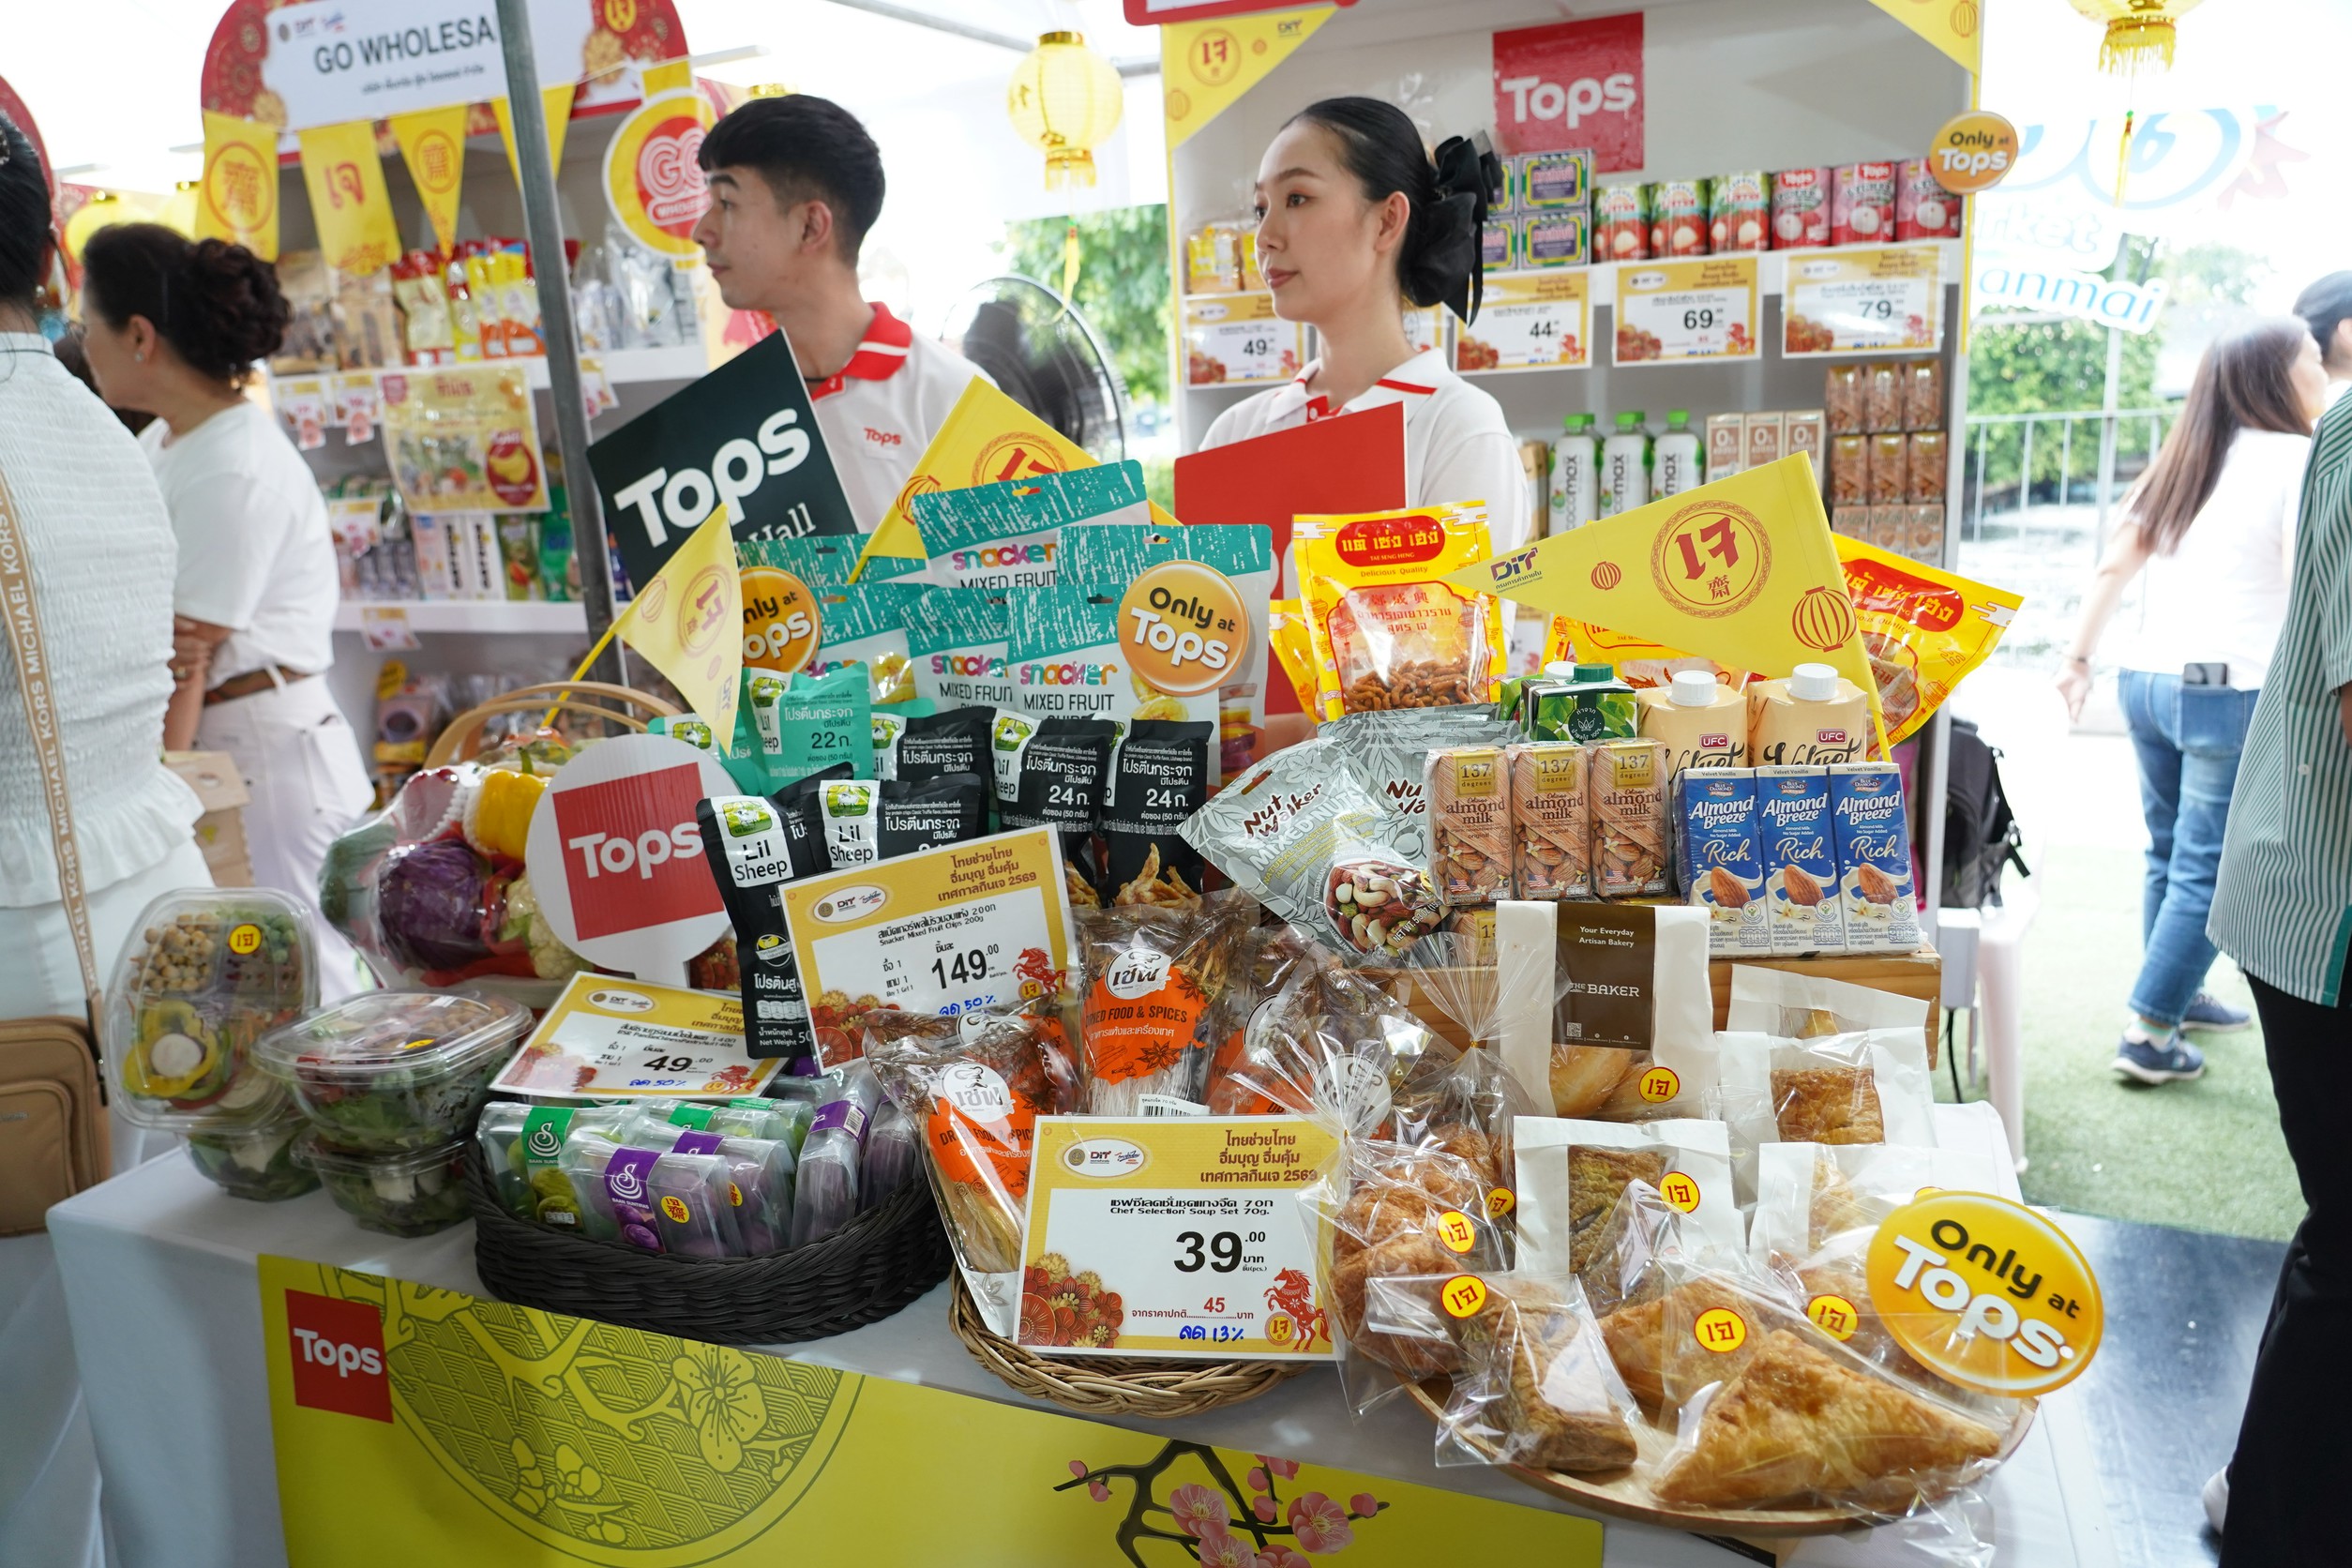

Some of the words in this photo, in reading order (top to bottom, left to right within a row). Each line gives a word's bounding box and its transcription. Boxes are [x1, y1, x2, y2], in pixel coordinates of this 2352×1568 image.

[314, 42, 354, 74] GO
[358, 15, 496, 67] WHOLESA
[1500, 73, 1637, 128] Tops
[1949, 130, 1996, 149] Only
[1937, 147, 2009, 177] Tops
[1683, 308, 1714, 330] 69
[1858, 300, 1893, 321] 79
[1529, 321, 1553, 339] 44
[1243, 338, 1269, 356] 49
[863, 427, 902, 447] Tops
[613, 407, 811, 549] Tops
[1674, 516, 1739, 581] เจ
[1360, 569, 1396, 578] Delicious
[1399, 565, 1428, 576] Quality
[743, 594, 780, 623] nly
[783, 590, 798, 607] at
[1148, 586, 1214, 630] Only
[1216, 616, 1236, 633] at
[8, 579, 41, 674] MICHAEL
[743, 610, 812, 665] ops
[1129, 606, 1230, 671] Tops
[1019, 659, 1118, 686] snacker
[939, 681, 972, 700] MIXED
[30, 679, 53, 740] KORS
[1023, 694, 1065, 711] MIXED
[1069, 694, 1115, 711] FRUIT
[784, 705, 853, 722] โปรตีนกระจก
[810, 731, 837, 750] 22
[1702, 736, 1726, 747] UFC
[1820, 731, 1845, 742] UFC
[902, 750, 973, 765] โปรตีนกระจก
[1026, 755, 1097, 776] โปรตีนกระจก
[1540, 759, 1571, 775] 137
[1618, 754, 1650, 771] 137
[1123, 758, 1193, 777] โปรตีนกระจก
[1460, 762, 1491, 779] 137
[42, 740, 71, 839] MICHAEL
[1048, 784, 1075, 806] 24
[1146, 788, 1170, 808] 24
[1603, 789, 1664, 806] almond
[1446, 800, 1506, 815] almond
[1525, 794, 1585, 810] almond
[1620, 802, 1652, 816] milk
[1689, 794, 1756, 821] Almond
[1761, 792, 1828, 819] Almond
[1835, 791, 1901, 816] Almond
[884, 815, 961, 832] โปรตีนกระจก
[1462, 812, 1493, 824] milk
[1541, 807, 1573, 821] milk
[1703, 811, 1747, 830] Breeze
[1775, 809, 1820, 828] Breeze
[1848, 807, 1893, 826] Breeze
[838, 825, 861, 843] Lil
[568, 822, 704, 880] Tops
[744, 839, 771, 861] Lil
[829, 845, 874, 865] Sheep
[950, 845, 1013, 870] ไทยช่วยไทย
[1702, 837, 1751, 867] Rich
[1775, 836, 1824, 864] Rich
[1849, 835, 1899, 862] Rich
[59, 837, 83, 898] KORS
[734, 858, 789, 882] Sheep
[949, 866, 985, 885] อิ่มบุญ
[988, 859, 1019, 878] อิ่มคุ้ม
[938, 879, 1005, 902] เทศกาลกินเจ
[1009, 871, 1037, 887] 2569
[880, 934, 906, 946] Snacker
[907, 929, 927, 941] Mixed
[928, 925, 944, 935] Fruit
[945, 920, 963, 931] Chips
[1579, 926, 1598, 935] Your
[1600, 927, 1635, 937] Everyday
[1578, 937, 1606, 946] Artisan
[1608, 938, 1635, 948] Bakery
[931, 949, 987, 990] 149
[1587, 983, 1639, 997] BAKER
[1108, 1006, 1134, 1020] FOOD
[1136, 1005, 1145, 1018] &
[1149, 1005, 1188, 1023] SPICES
[774, 1038, 797, 1047] Weight
[643, 1055, 694, 1072] 49
[1225, 1128, 1296, 1147] ไทยช่วยไทย
[1219, 1151, 1259, 1167] อิ่มบุญ
[1262, 1151, 1301, 1168] อิ่มคุ้ม
[1200, 1169, 1280, 1184] เทศกาลกินเจ
[1110, 1207, 1135, 1215] Chef
[1138, 1207, 1185, 1215] Selection
[1189, 1207, 1216, 1216] Soup
[1221, 1207, 1239, 1215] Set
[1172, 1230, 1244, 1274] 39
[1243, 1254, 1265, 1265] บาท
[1930, 1218, 2043, 1300] Only
[2047, 1289, 2081, 1319] at
[1203, 1297, 1226, 1312] 45
[1892, 1234, 2066, 1368] Tops
[1236, 1311, 1254, 1320] บาท
[293, 1326, 384, 1379] Tops
